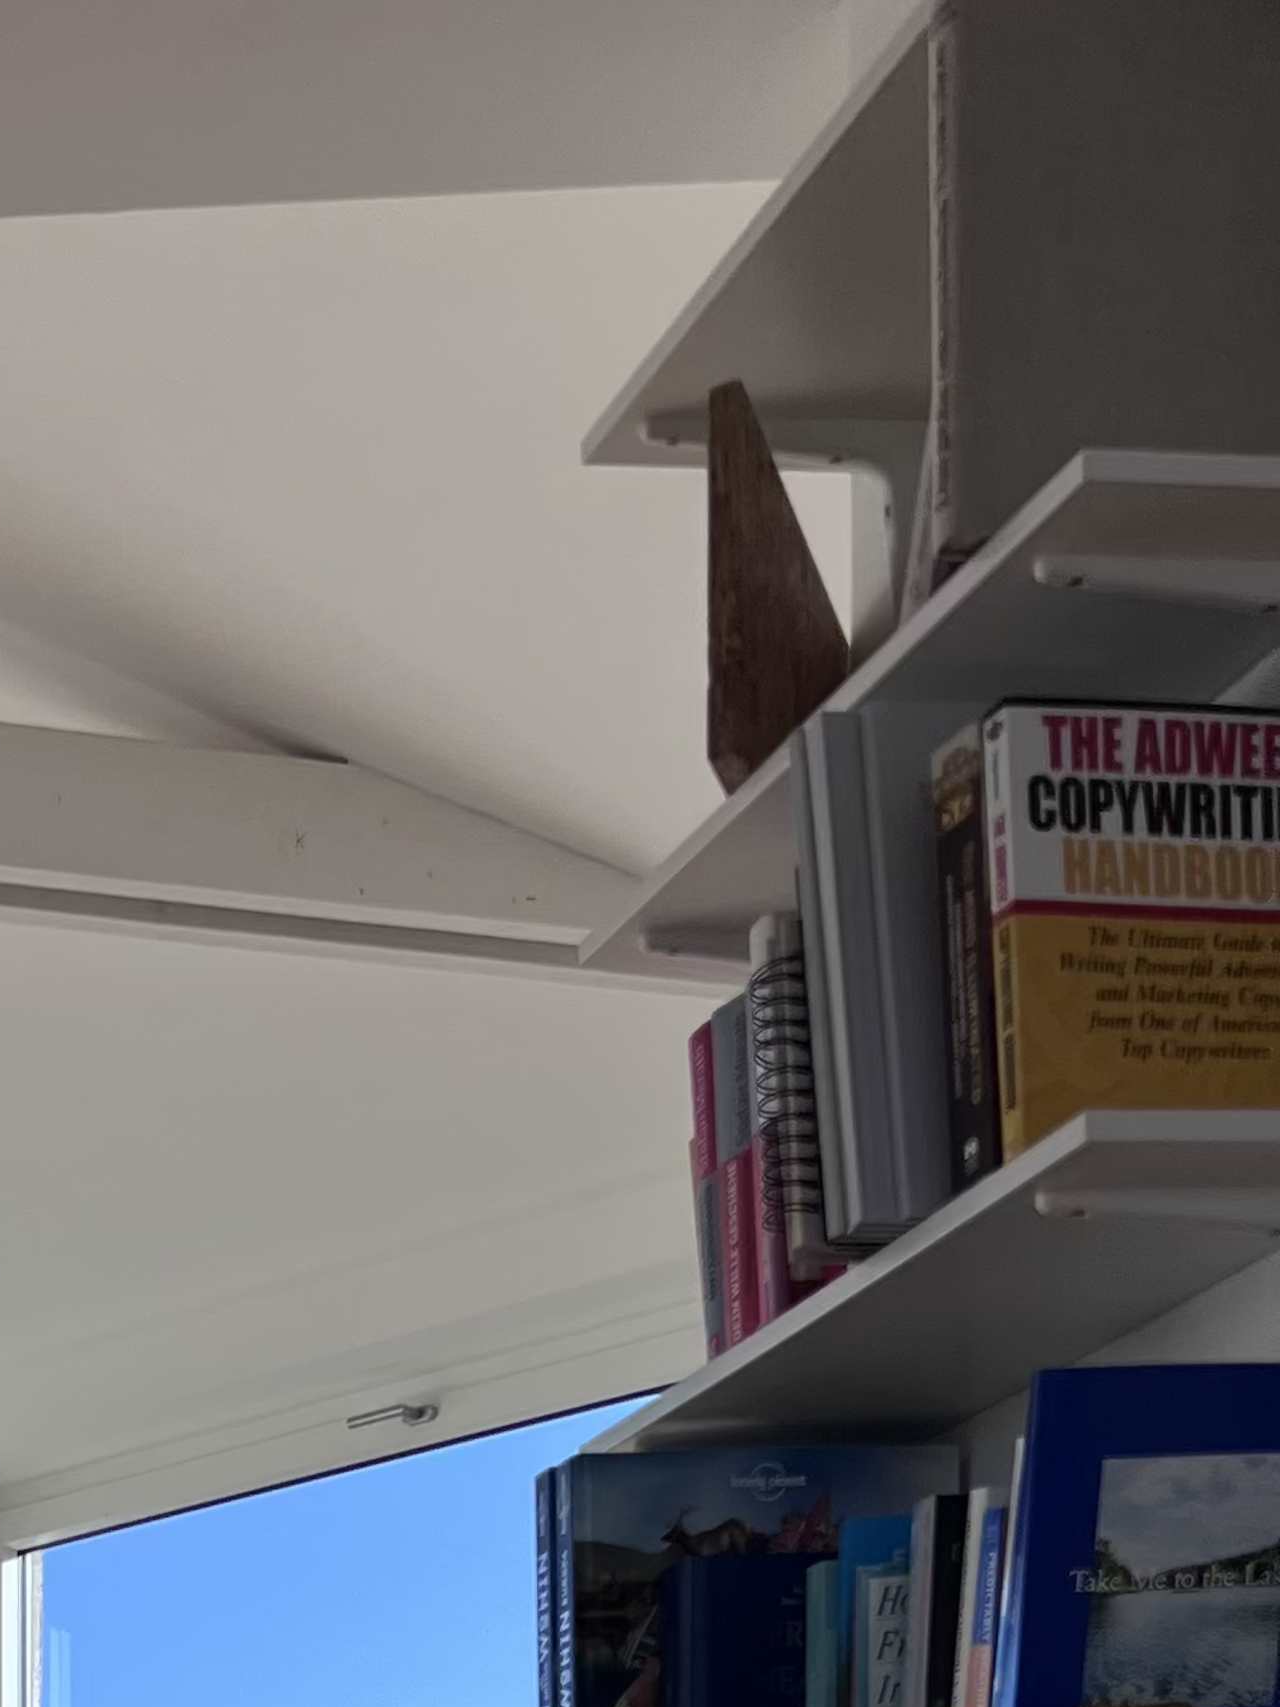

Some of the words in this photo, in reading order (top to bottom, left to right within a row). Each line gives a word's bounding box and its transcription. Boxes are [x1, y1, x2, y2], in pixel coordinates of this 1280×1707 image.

[1042, 715, 1122, 772] THE
[1028, 775, 1280, 842] COPYWRITI
[1069, 1567, 1122, 1593] Take
[1174, 1570, 1195, 1589] to
[1202, 1564, 1236, 1588] the
